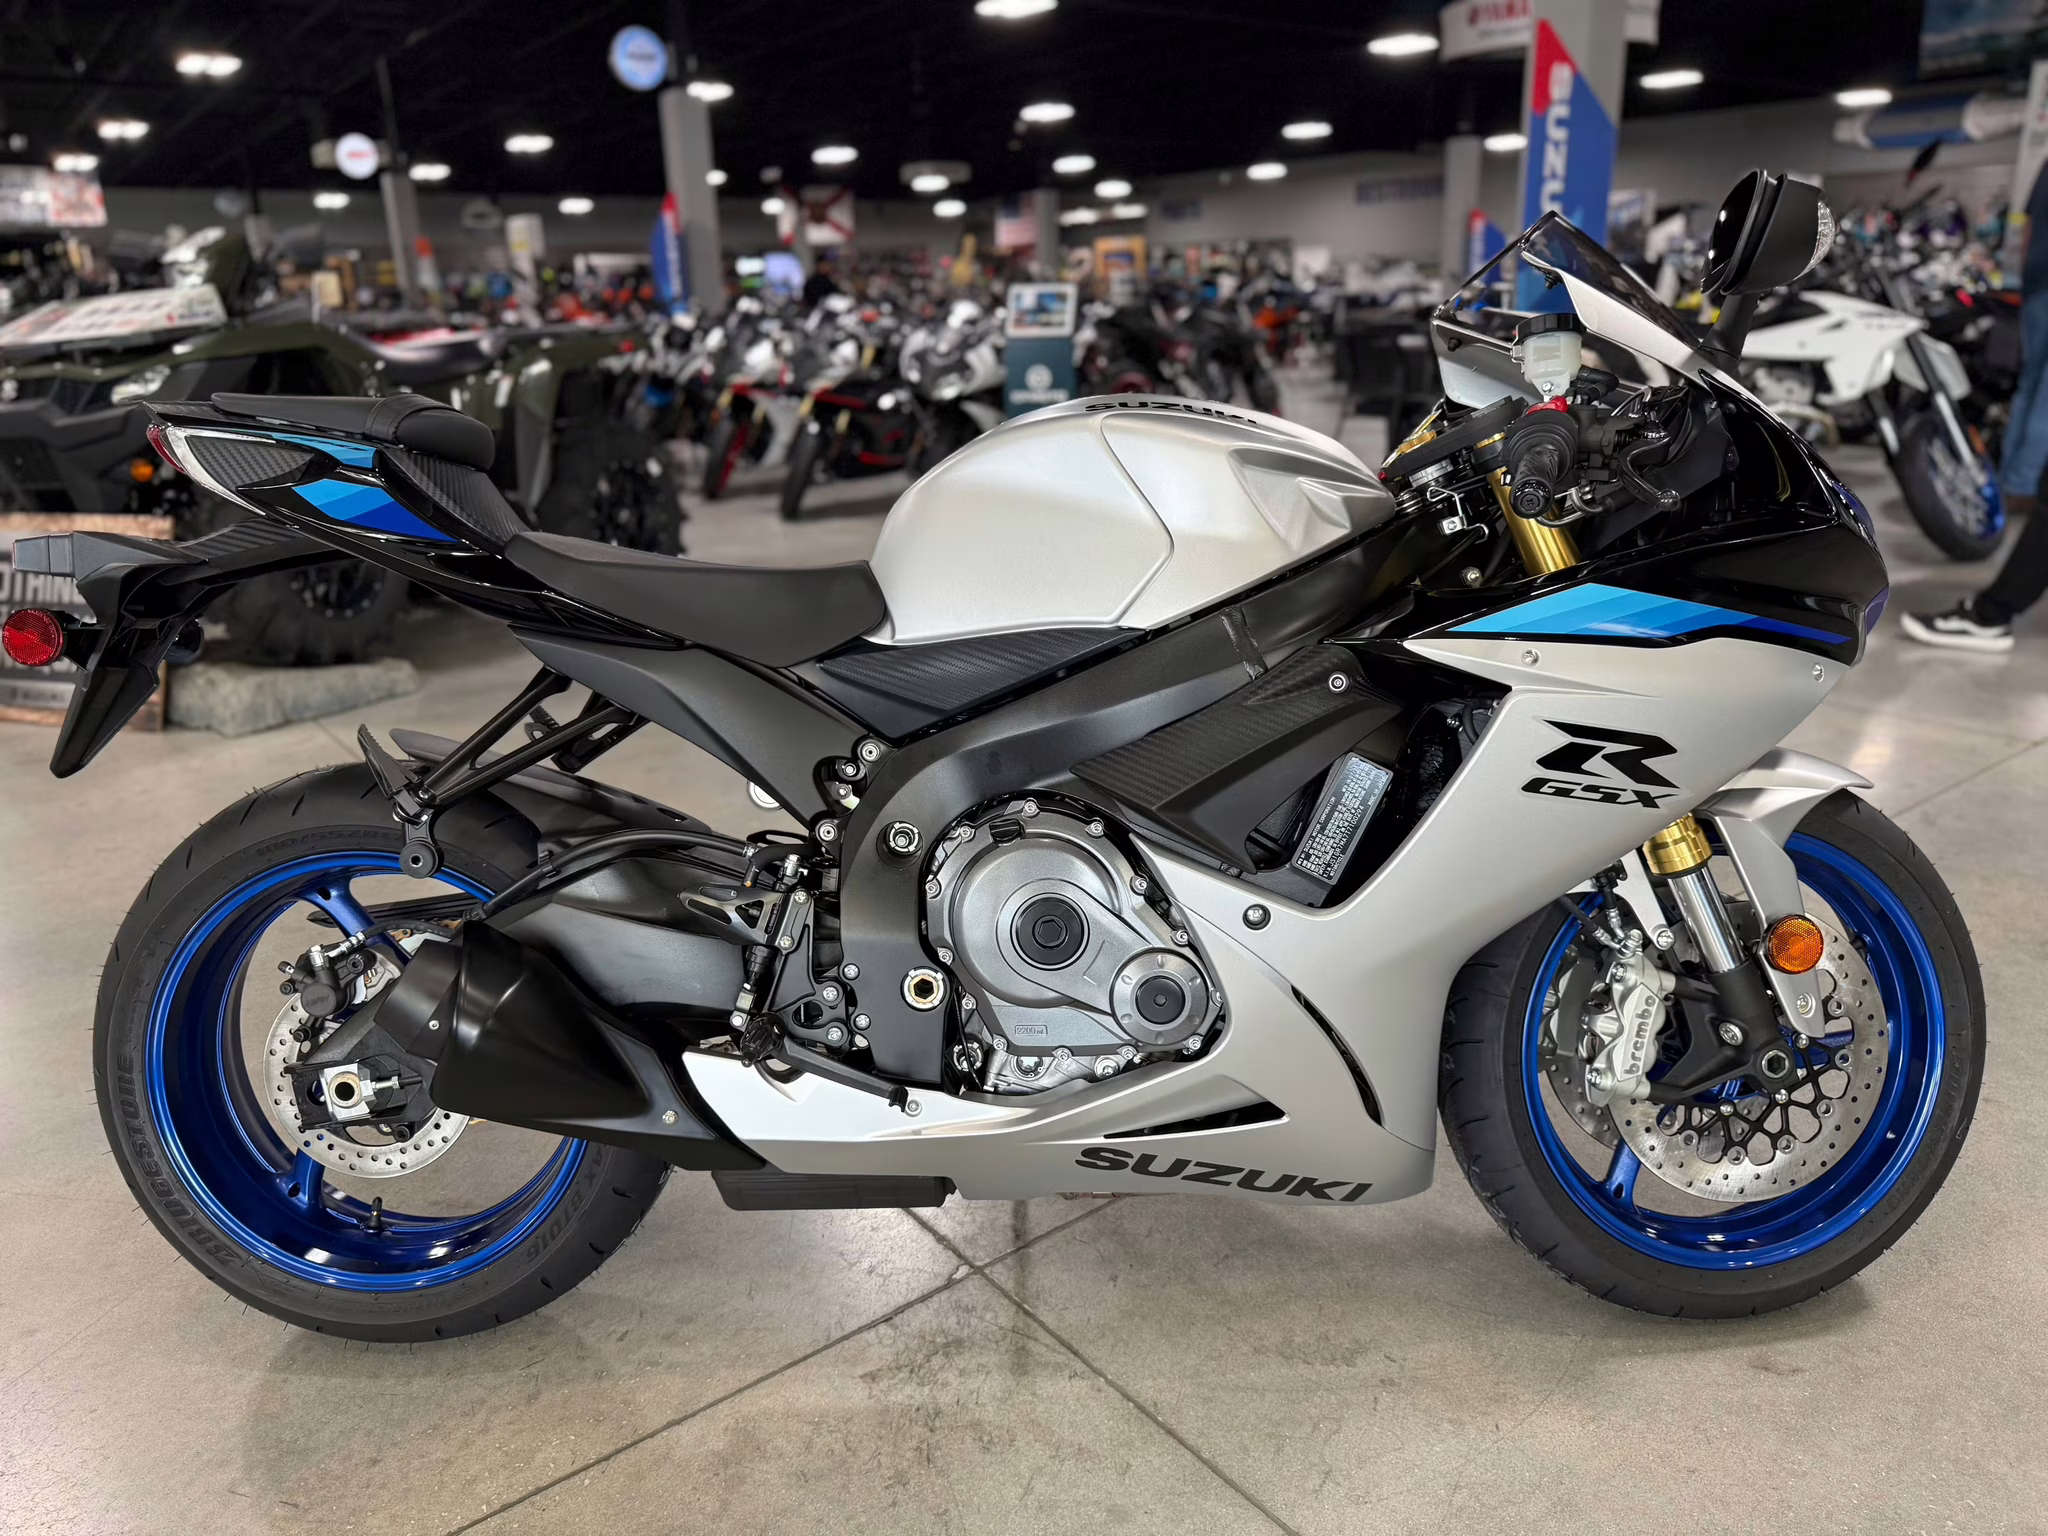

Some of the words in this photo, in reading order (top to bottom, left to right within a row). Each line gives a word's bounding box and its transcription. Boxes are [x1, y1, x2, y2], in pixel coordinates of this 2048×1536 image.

[1540, 61, 1574, 214] SUZU
[1536, 719, 1681, 789] R
[1303, 837, 1313, 852] SUZUKI
[1311, 823, 1321, 836] MOTOR
[1318, 795, 1336, 823] CORPORATION
[1521, 777, 1679, 809] GSX
[1623, 995, 1656, 1075] brembo
[117, 1053, 243, 1266] BRIDGESTONE
[1075, 1147, 1374, 1202] SUZUKI
